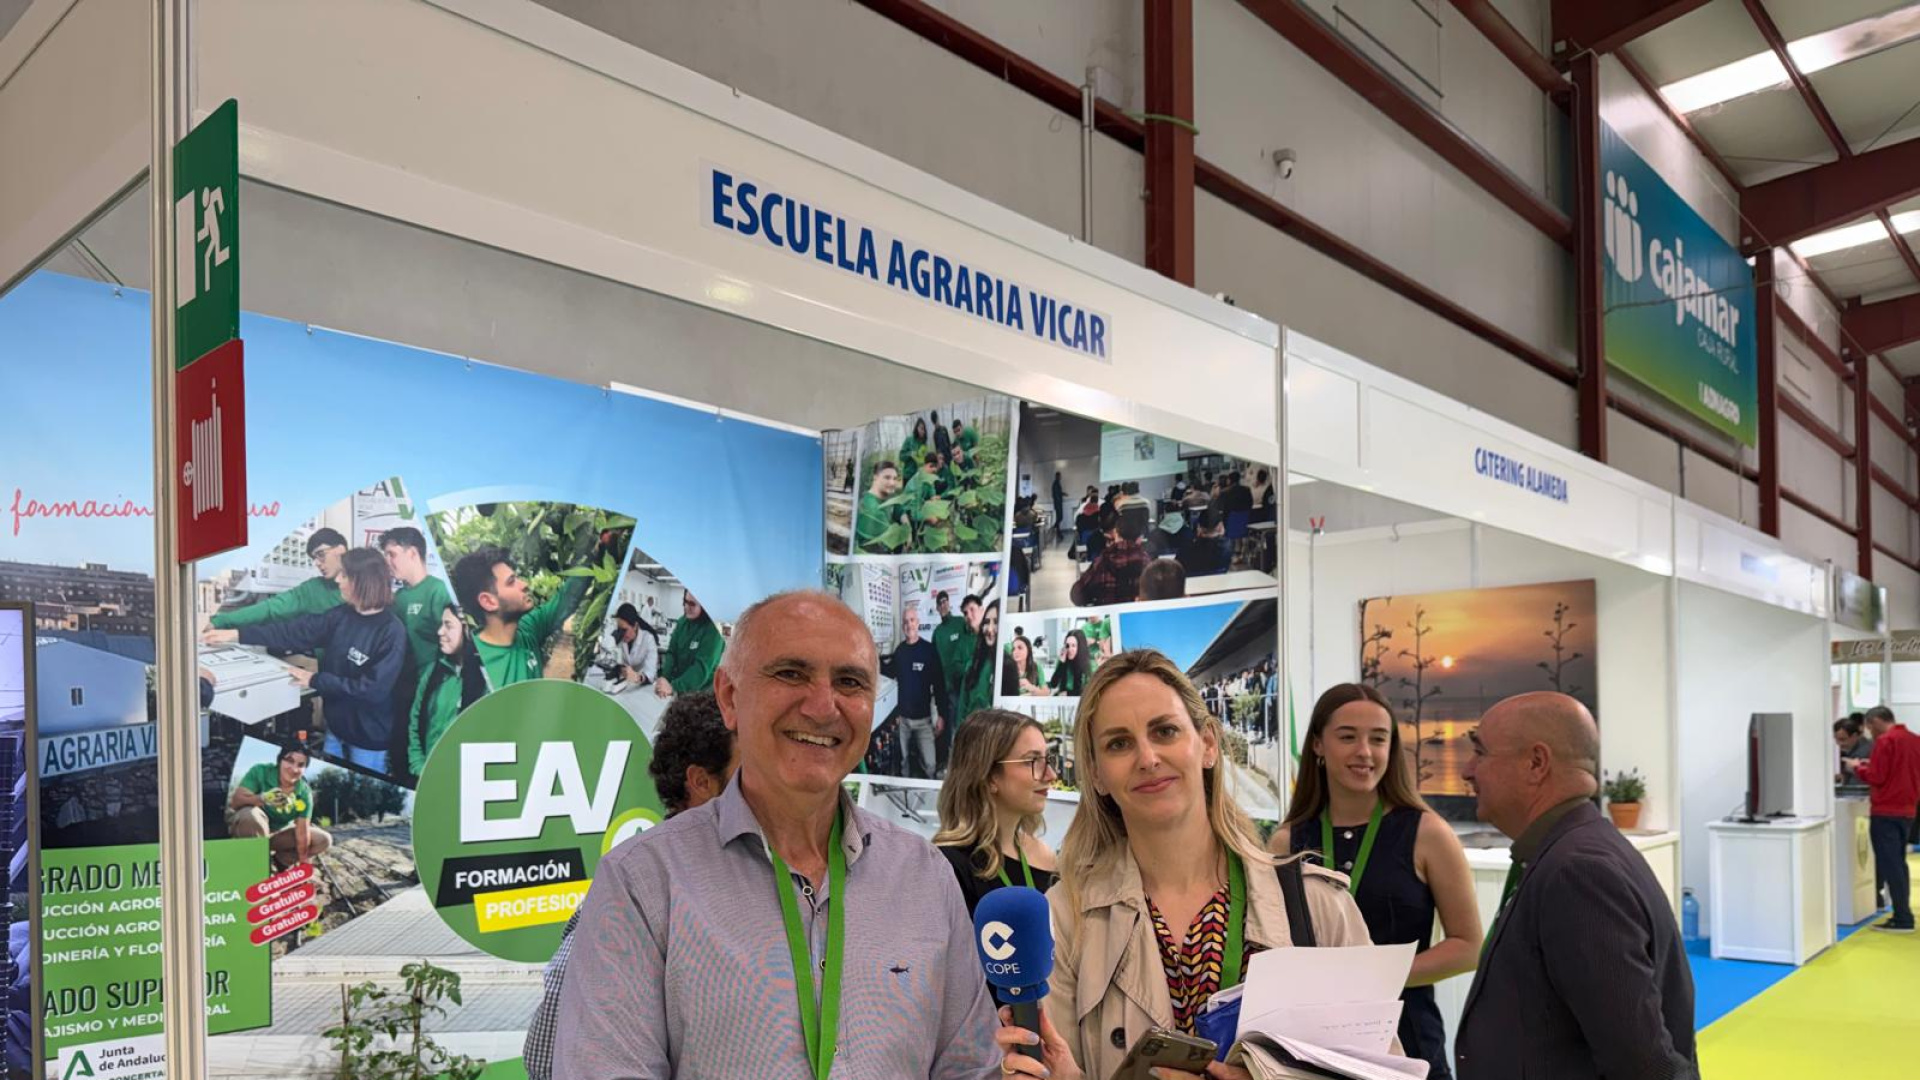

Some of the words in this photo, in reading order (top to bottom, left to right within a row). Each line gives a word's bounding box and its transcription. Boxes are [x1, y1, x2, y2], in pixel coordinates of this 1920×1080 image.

[712, 169, 878, 281] ESCUELA
[887, 240, 1024, 330] AGRARIA
[1029, 291, 1106, 358] VICAR
[1649, 237, 1740, 348] cajamar
[1475, 447, 1525, 488] CATERING
[1526, 466, 1569, 503] ALAMEDA
[43, 729, 138, 774] AGRARIA
[460, 740, 632, 844] EAV
[257, 868, 306, 894] Gratuito
[455, 860, 571, 889] FORMACIÓN
[259, 889, 307, 915] Gratuito
[43, 923, 109, 941] UCCIÓN
[262, 910, 310, 936] Gratuito
[42, 946, 109, 965] DINERÍA
[114, 946, 125, 957] Y
[985, 962, 1021, 974] COPE
[44, 984, 97, 1020] ADO
[44, 1020, 103, 1038] AJISMO
[107, 1018, 118, 1029] Y
[98, 1046, 135, 1059] Junta
[99, 1060, 114, 1071] de
[117, 1053, 166, 1070] Andaluc
